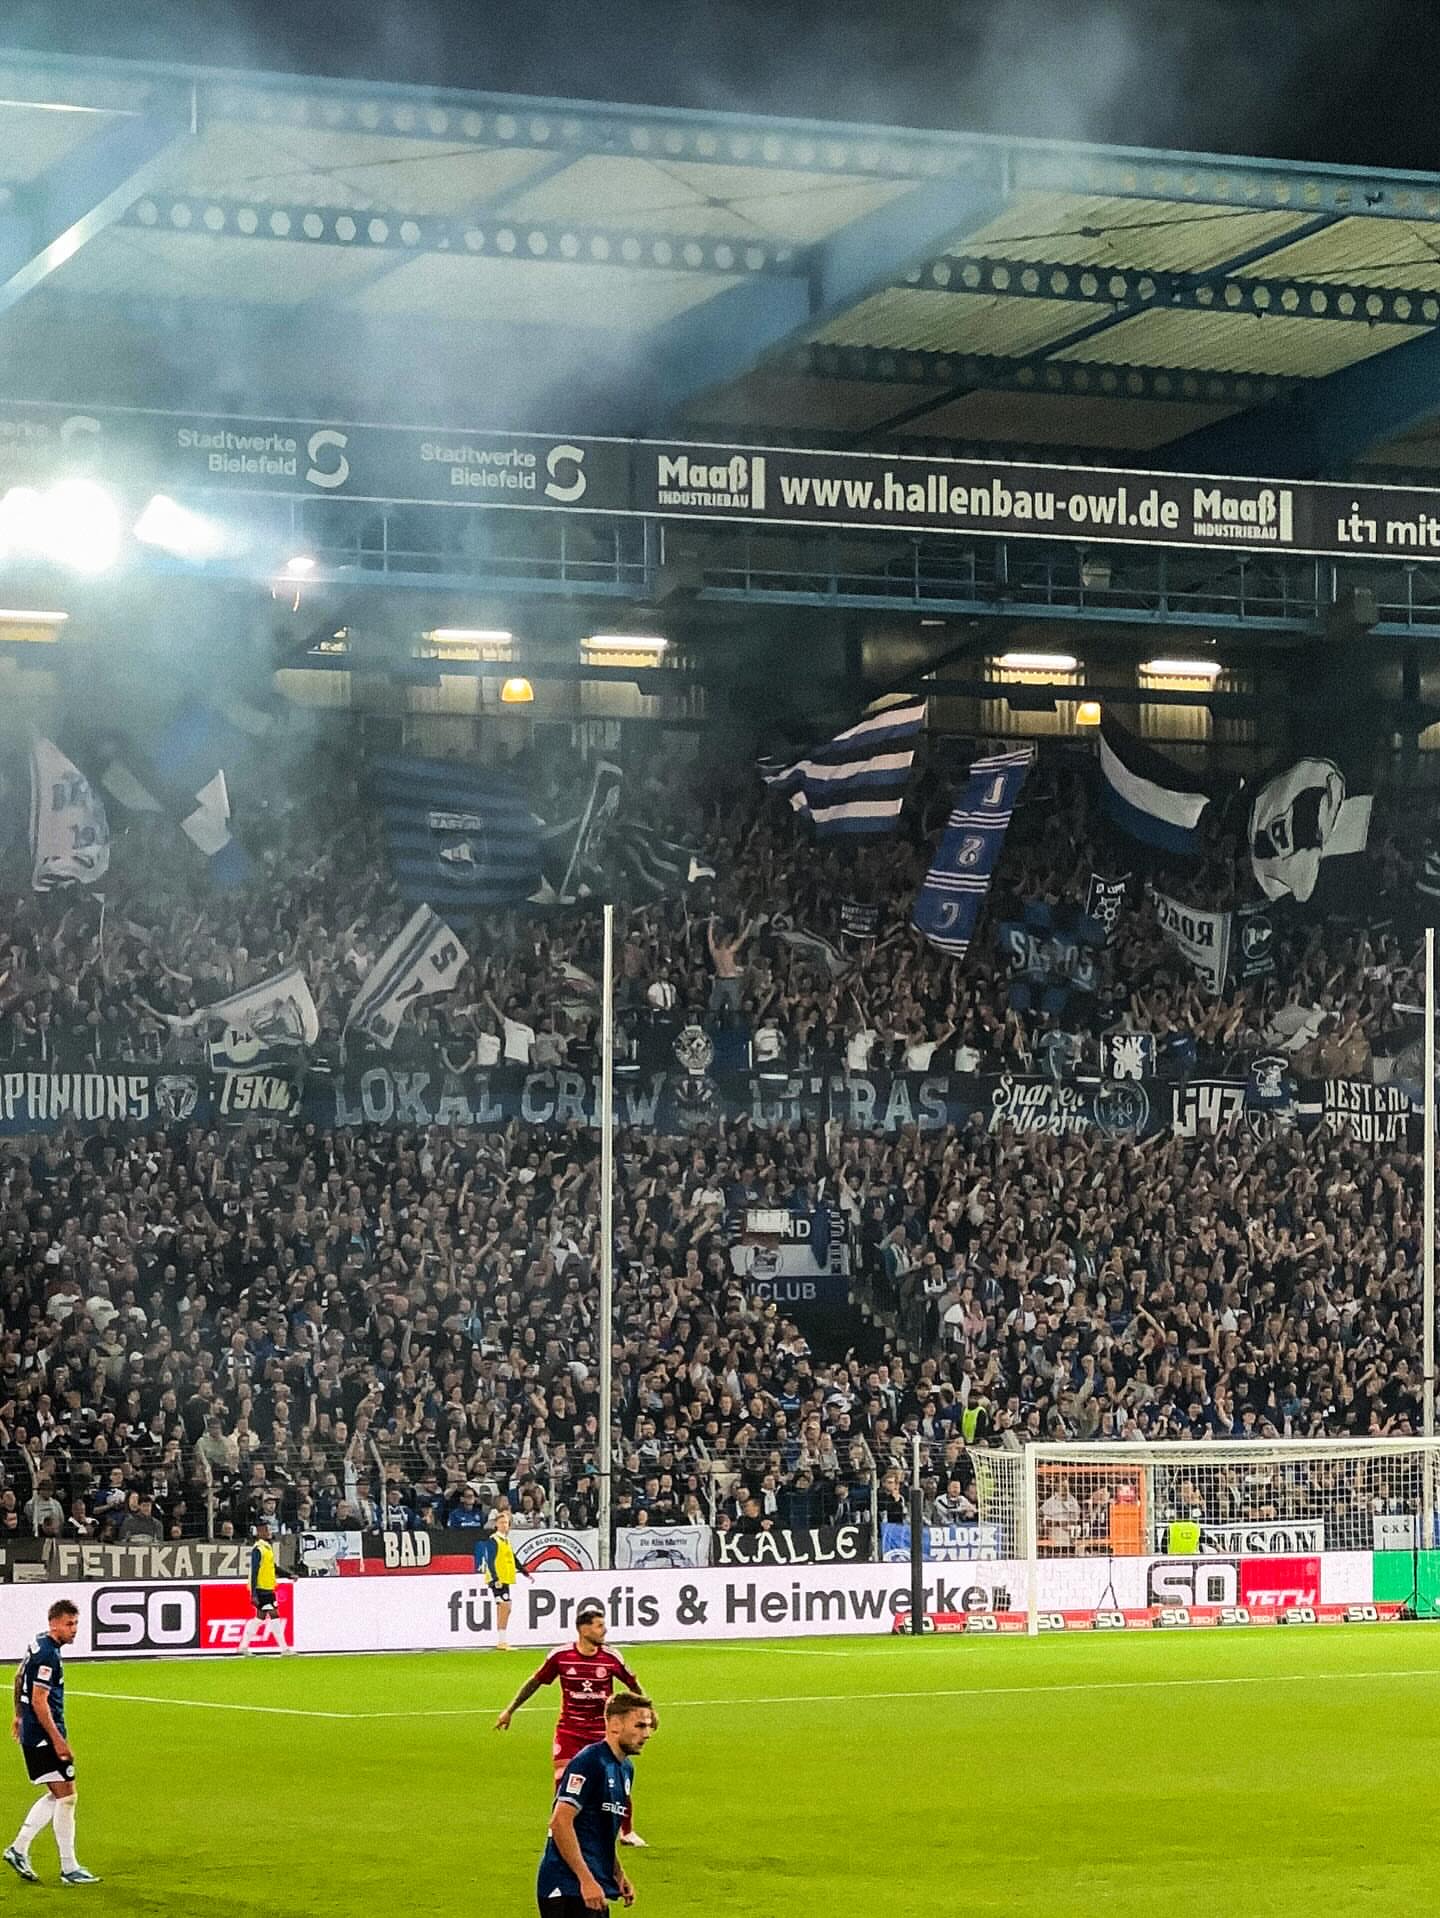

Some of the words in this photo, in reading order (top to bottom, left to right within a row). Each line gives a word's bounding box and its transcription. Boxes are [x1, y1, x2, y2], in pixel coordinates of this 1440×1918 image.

[177, 428, 297, 453] Stadtwerke
[419, 443, 537, 468] Stadtwerke
[208, 453, 297, 476] Bielefeld
[450, 467, 537, 490] Bielefeld
[657, 455, 749, 493] Maaß
[657, 490, 749, 508] INDUSTRIEBAU
[779, 471, 1180, 530] www.hallenbau-owl.de
[1193, 487, 1277, 525] Maaß
[1193, 521, 1278, 540] INDUSTRIEBAU
[0, 1072, 149, 1121] PANIONS
[335, 1067, 502, 1127] LOKAL
[748, 1076, 950, 1131] ULRAS
[383, 1530, 432, 1568] BAD
[930, 1526, 998, 1547] BLOCK
[57, 1541, 281, 1578] FETTKATZE
[95, 1589, 198, 1647] SO
[447, 1588, 494, 1633] fü
[675, 1584, 708, 1626] &
[725, 1577, 1012, 1624] Heimwerker
